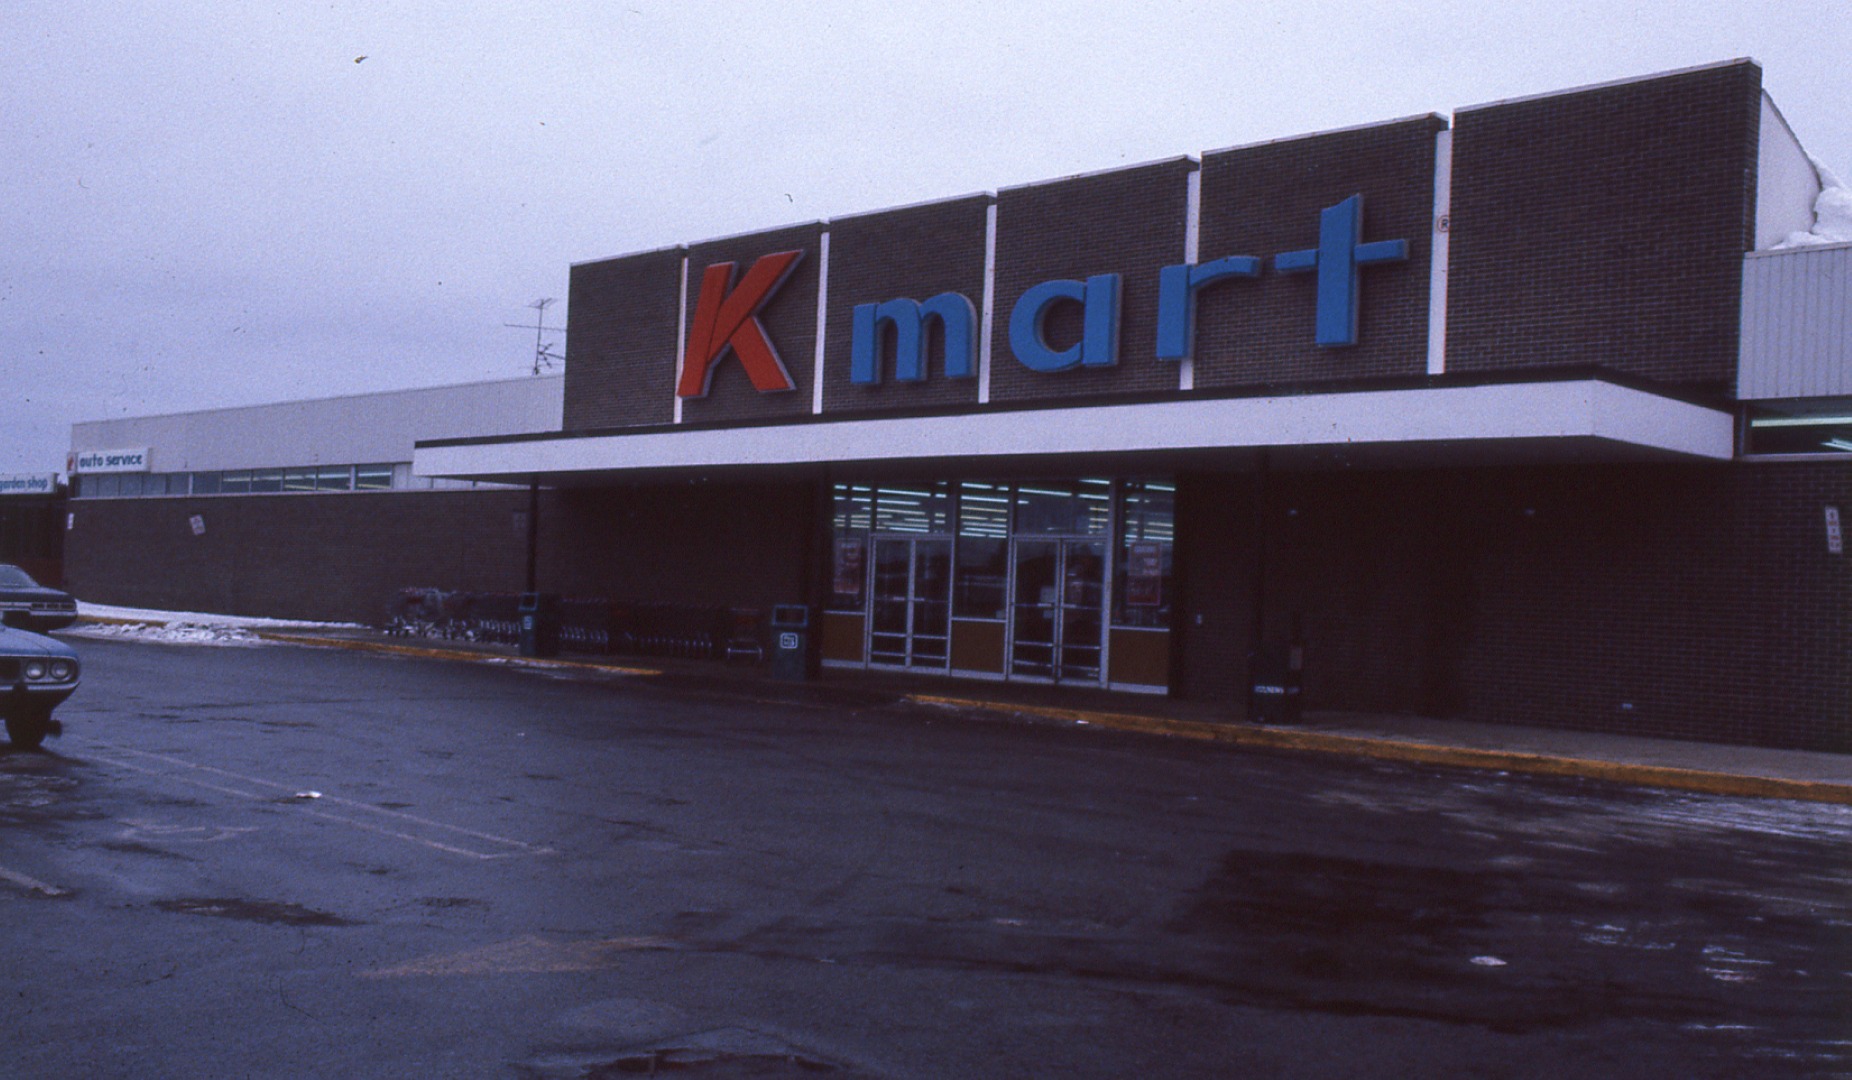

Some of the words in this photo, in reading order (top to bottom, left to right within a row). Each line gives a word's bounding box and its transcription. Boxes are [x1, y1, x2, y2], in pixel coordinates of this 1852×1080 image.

[79, 453, 104, 468] auto
[106, 453, 143, 466] service
[28, 475, 48, 489] shop
